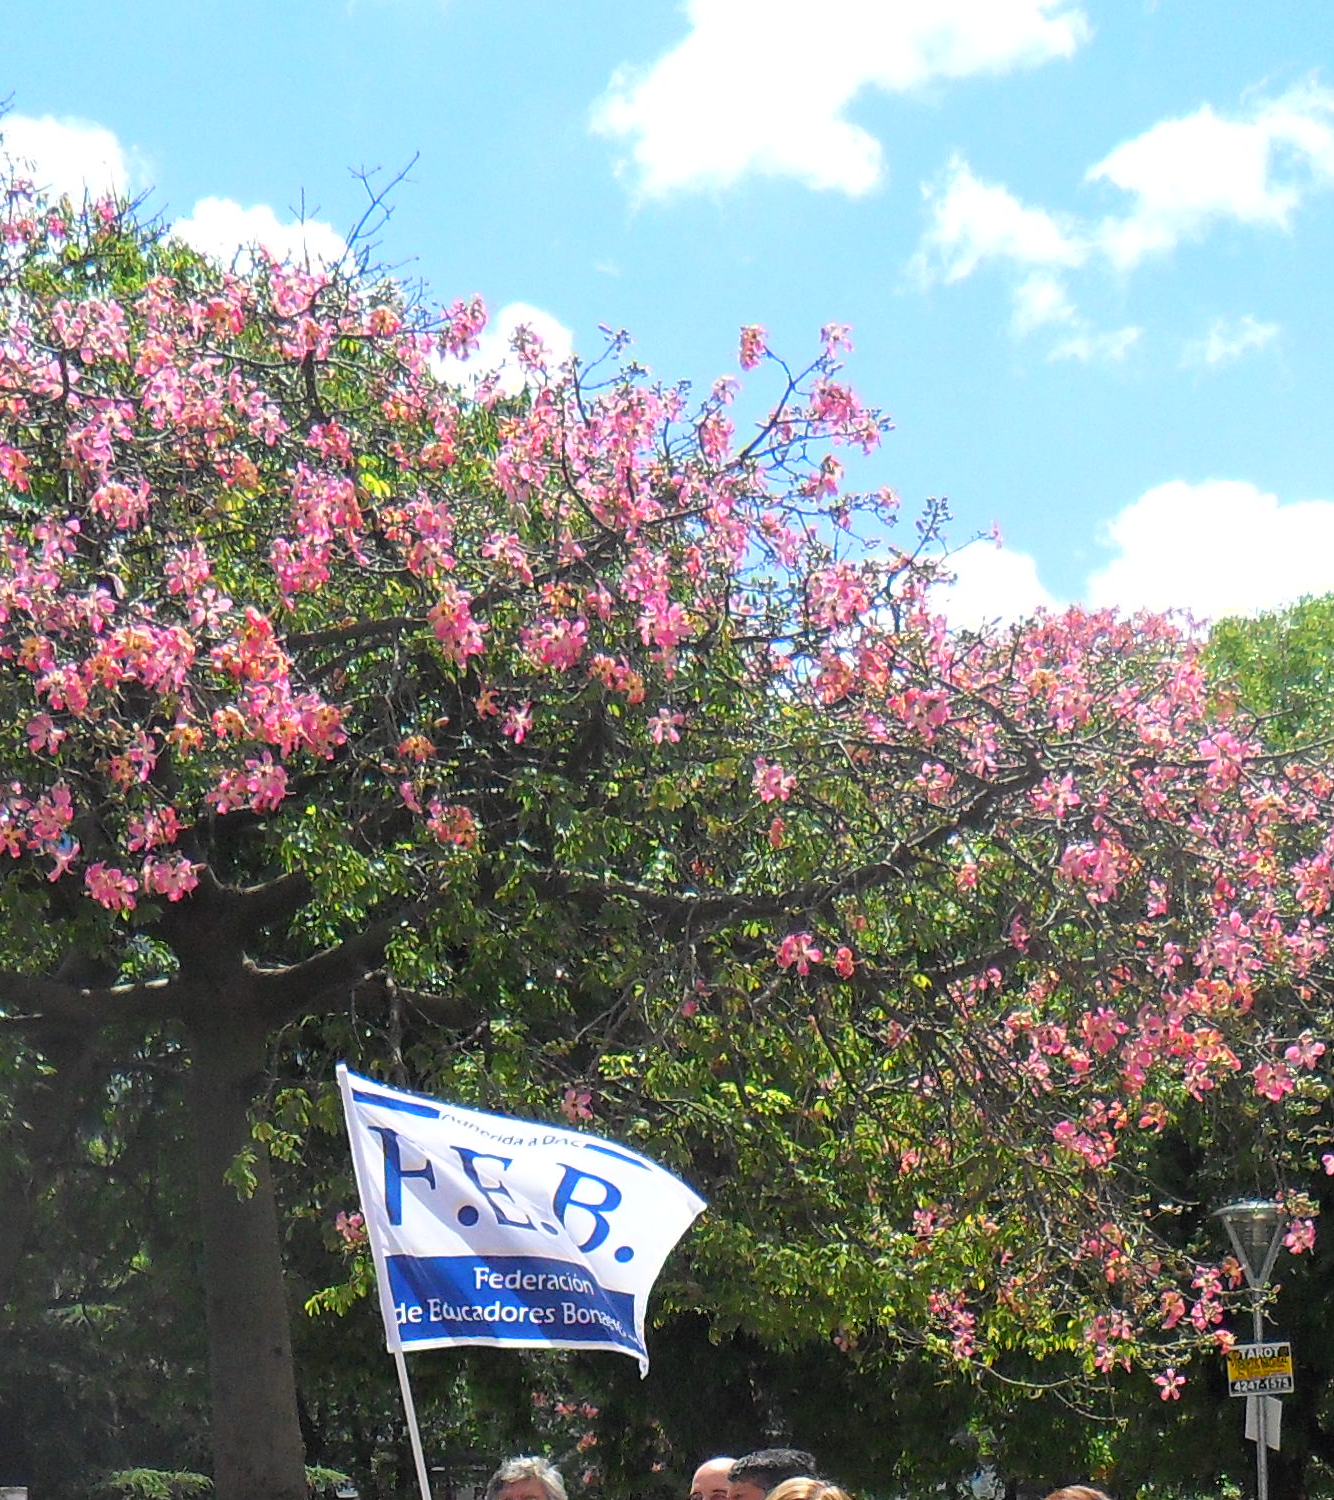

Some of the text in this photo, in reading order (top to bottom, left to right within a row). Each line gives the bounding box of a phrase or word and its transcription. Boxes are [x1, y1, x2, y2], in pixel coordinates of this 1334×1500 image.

[474, 1266, 594, 1295] Federación
[396, 1305, 422, 1324] de
[1239, 1346, 1279, 1360] TAROT
